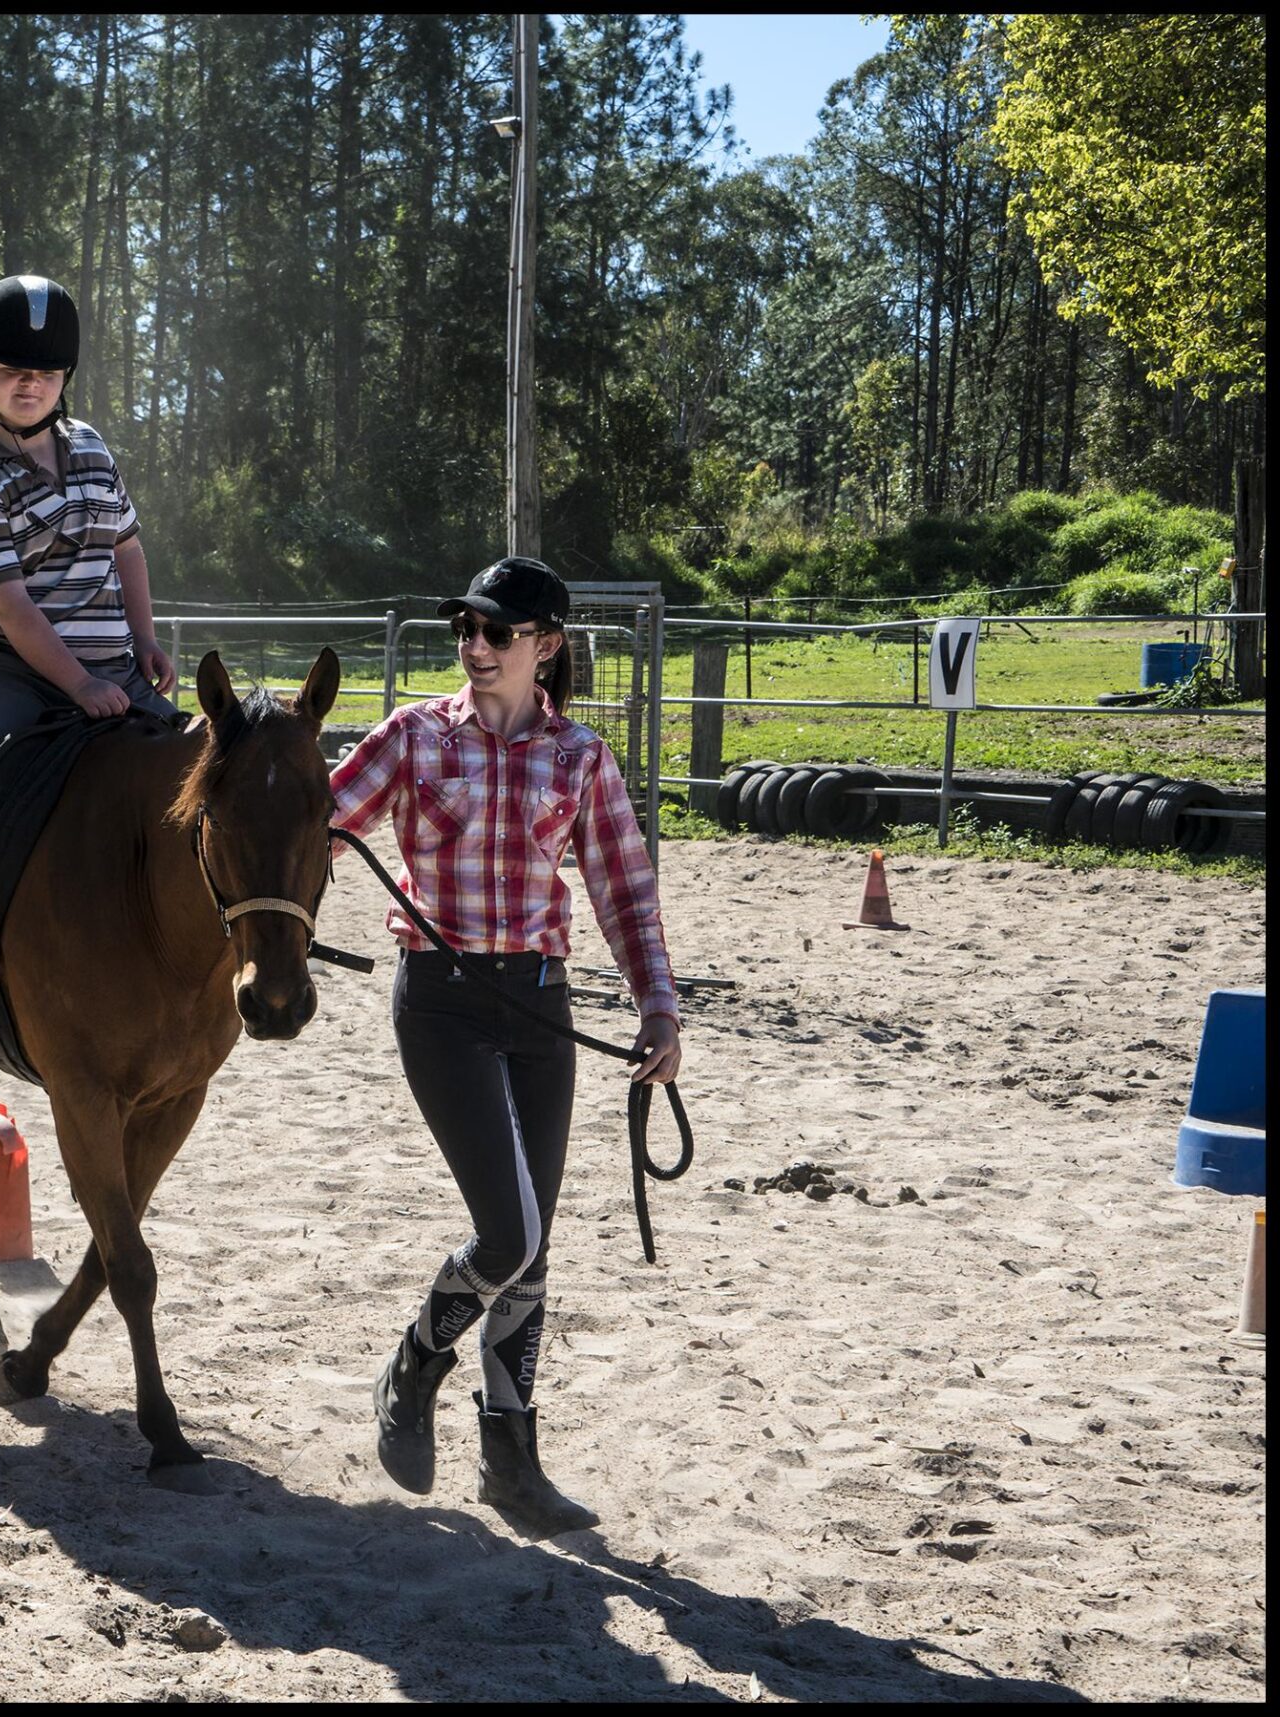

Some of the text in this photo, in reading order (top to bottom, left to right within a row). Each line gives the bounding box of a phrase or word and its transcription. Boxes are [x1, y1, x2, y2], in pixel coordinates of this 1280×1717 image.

[939, 632, 973, 695] V
[435, 1299, 475, 1338] HYPOLO
[517, 1324, 543, 1385] HYPOLO
